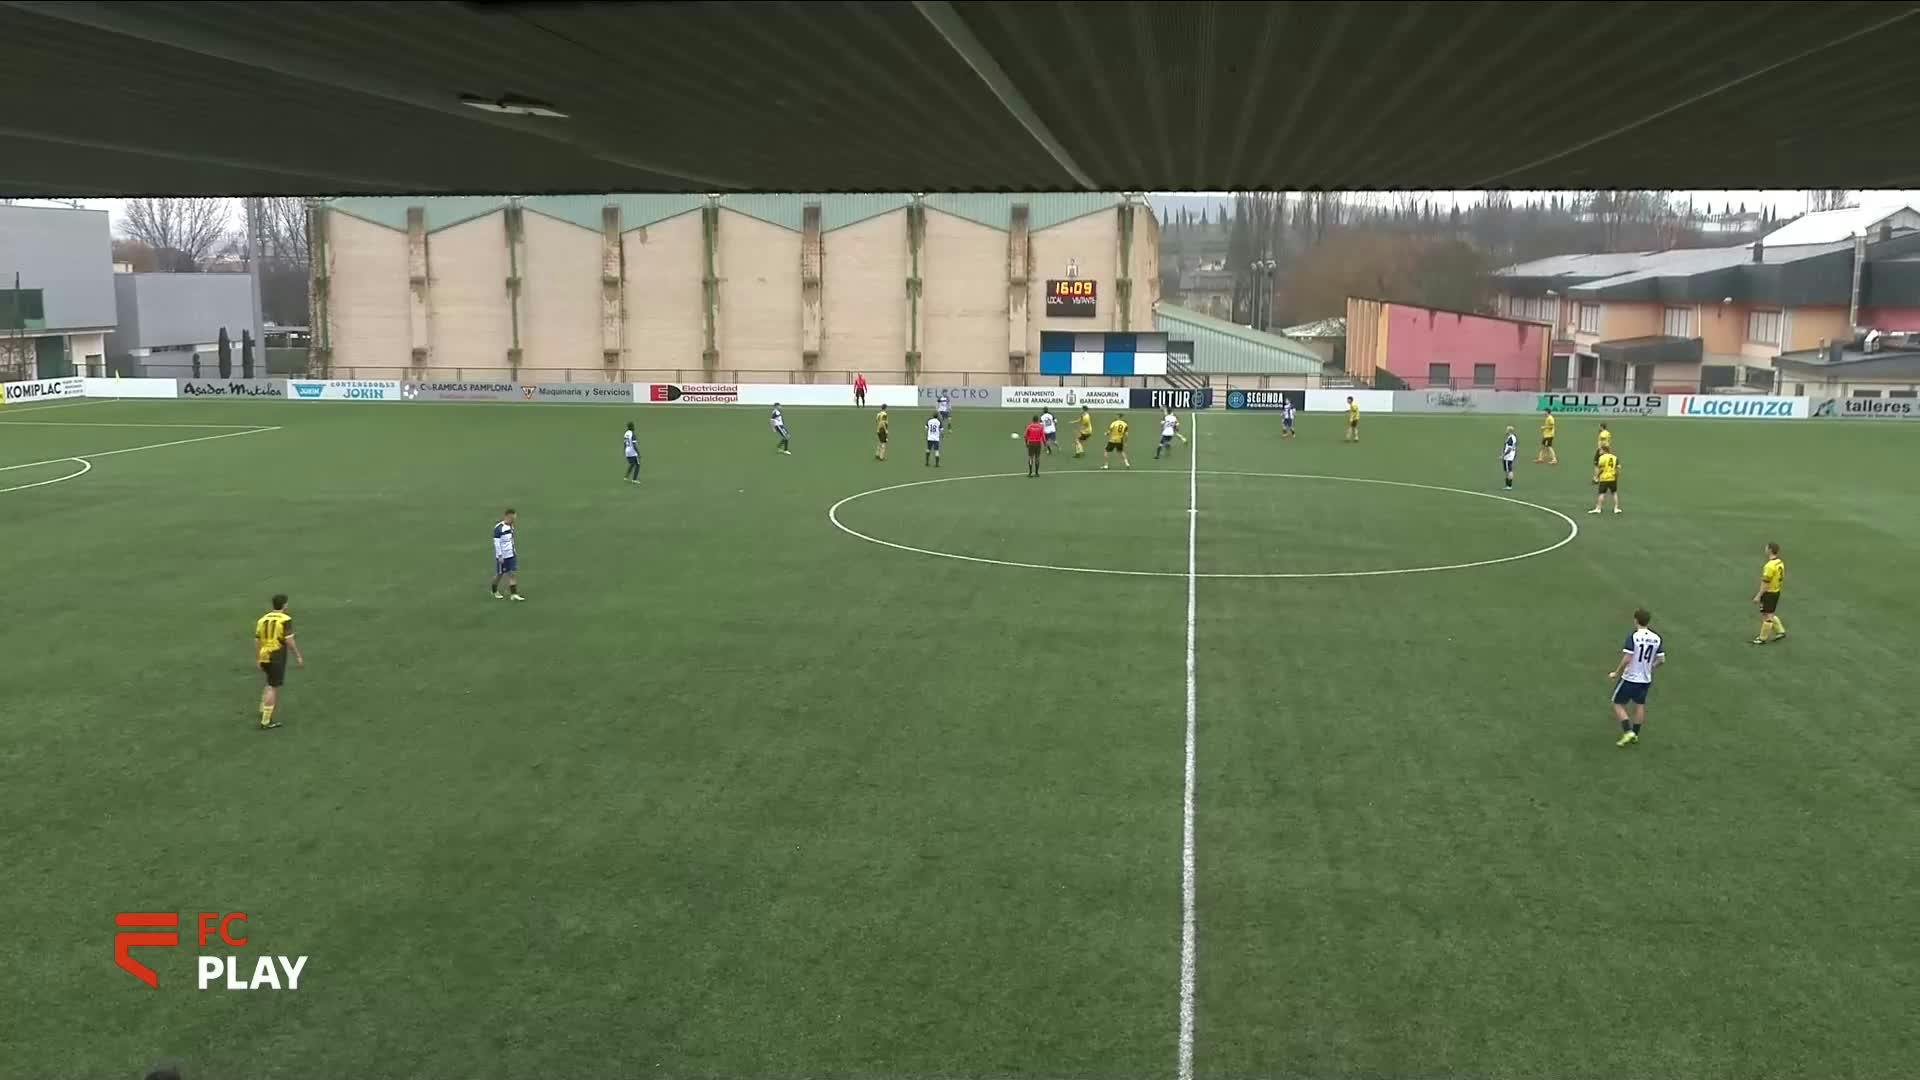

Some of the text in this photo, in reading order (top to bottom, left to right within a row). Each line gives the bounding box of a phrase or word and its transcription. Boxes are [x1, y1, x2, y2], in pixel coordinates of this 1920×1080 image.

[1055, 281, 1093, 295] 16:09
[6, 382, 62, 399] KOMIPLAC
[343, 388, 384, 399] JOKIN
[470, 384, 513, 392] PAMPLONA
[538, 387, 582, 397] Maquinaria
[585, 389, 590, 397] y
[593, 388, 631, 396] Servicios
[682, 384, 738, 392] Electricidad
[1246, 392, 1284, 403] SEGUNDA
[1544, 395, 1662, 407] TOLDOS
[1845, 399, 1911, 413] talleres
[1638, 643, 1654, 663] 14
